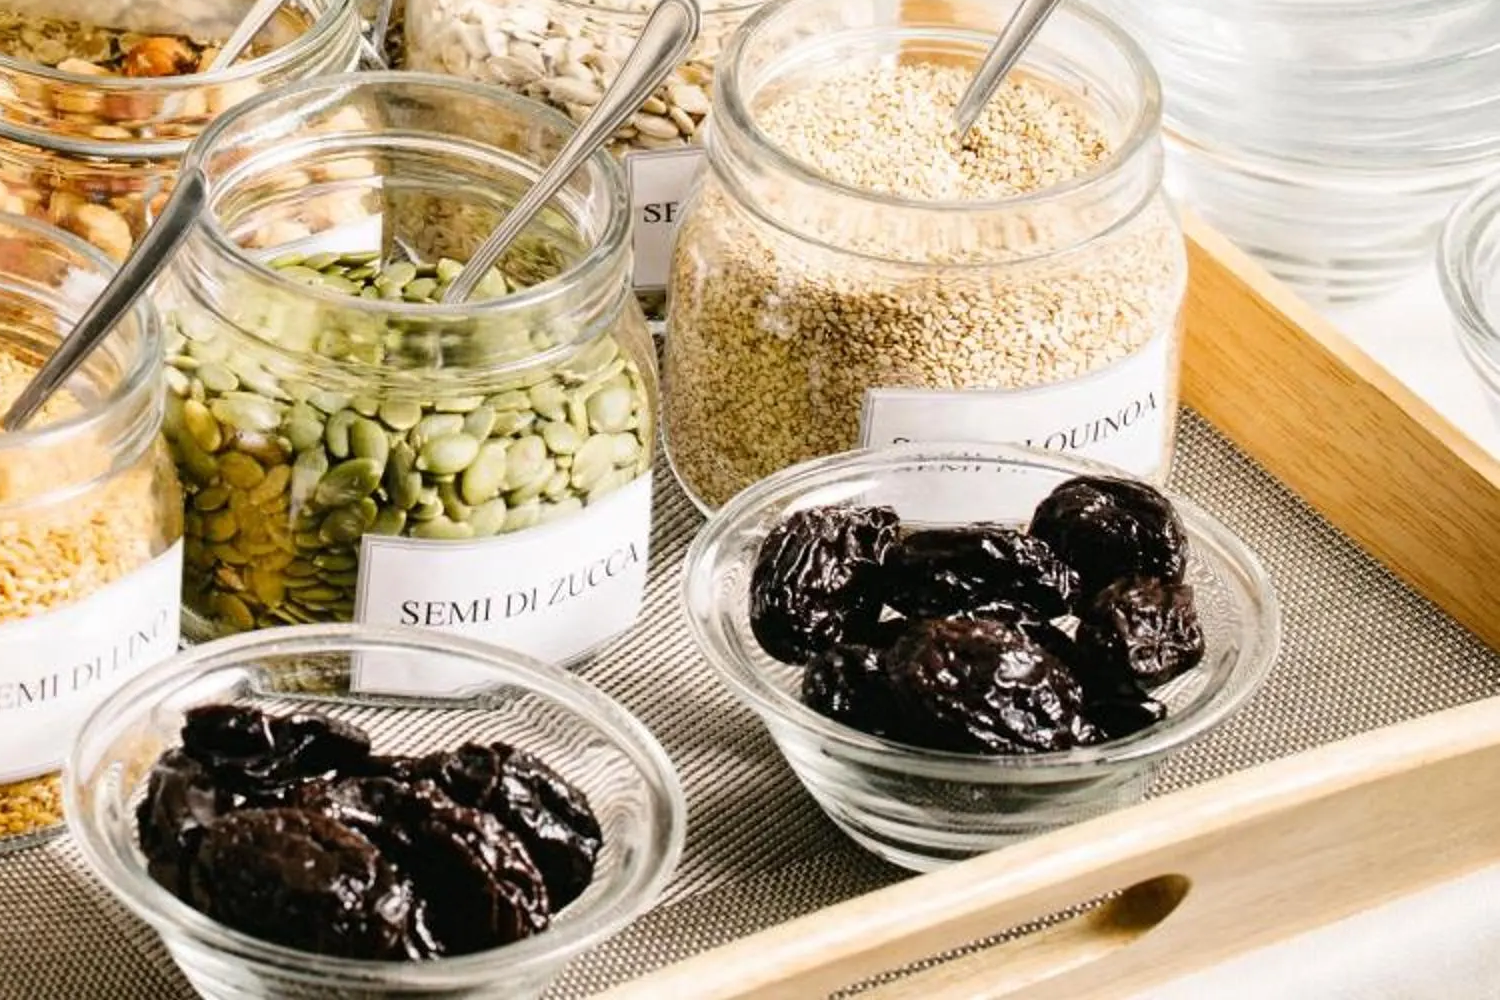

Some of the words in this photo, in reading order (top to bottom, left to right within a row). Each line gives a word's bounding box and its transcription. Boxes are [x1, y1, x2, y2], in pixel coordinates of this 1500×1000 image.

[400, 598, 492, 626] SEMI
[504, 587, 538, 619] DI
[547, 542, 639, 606] ZUCCA
[72, 656, 102, 691] DI
